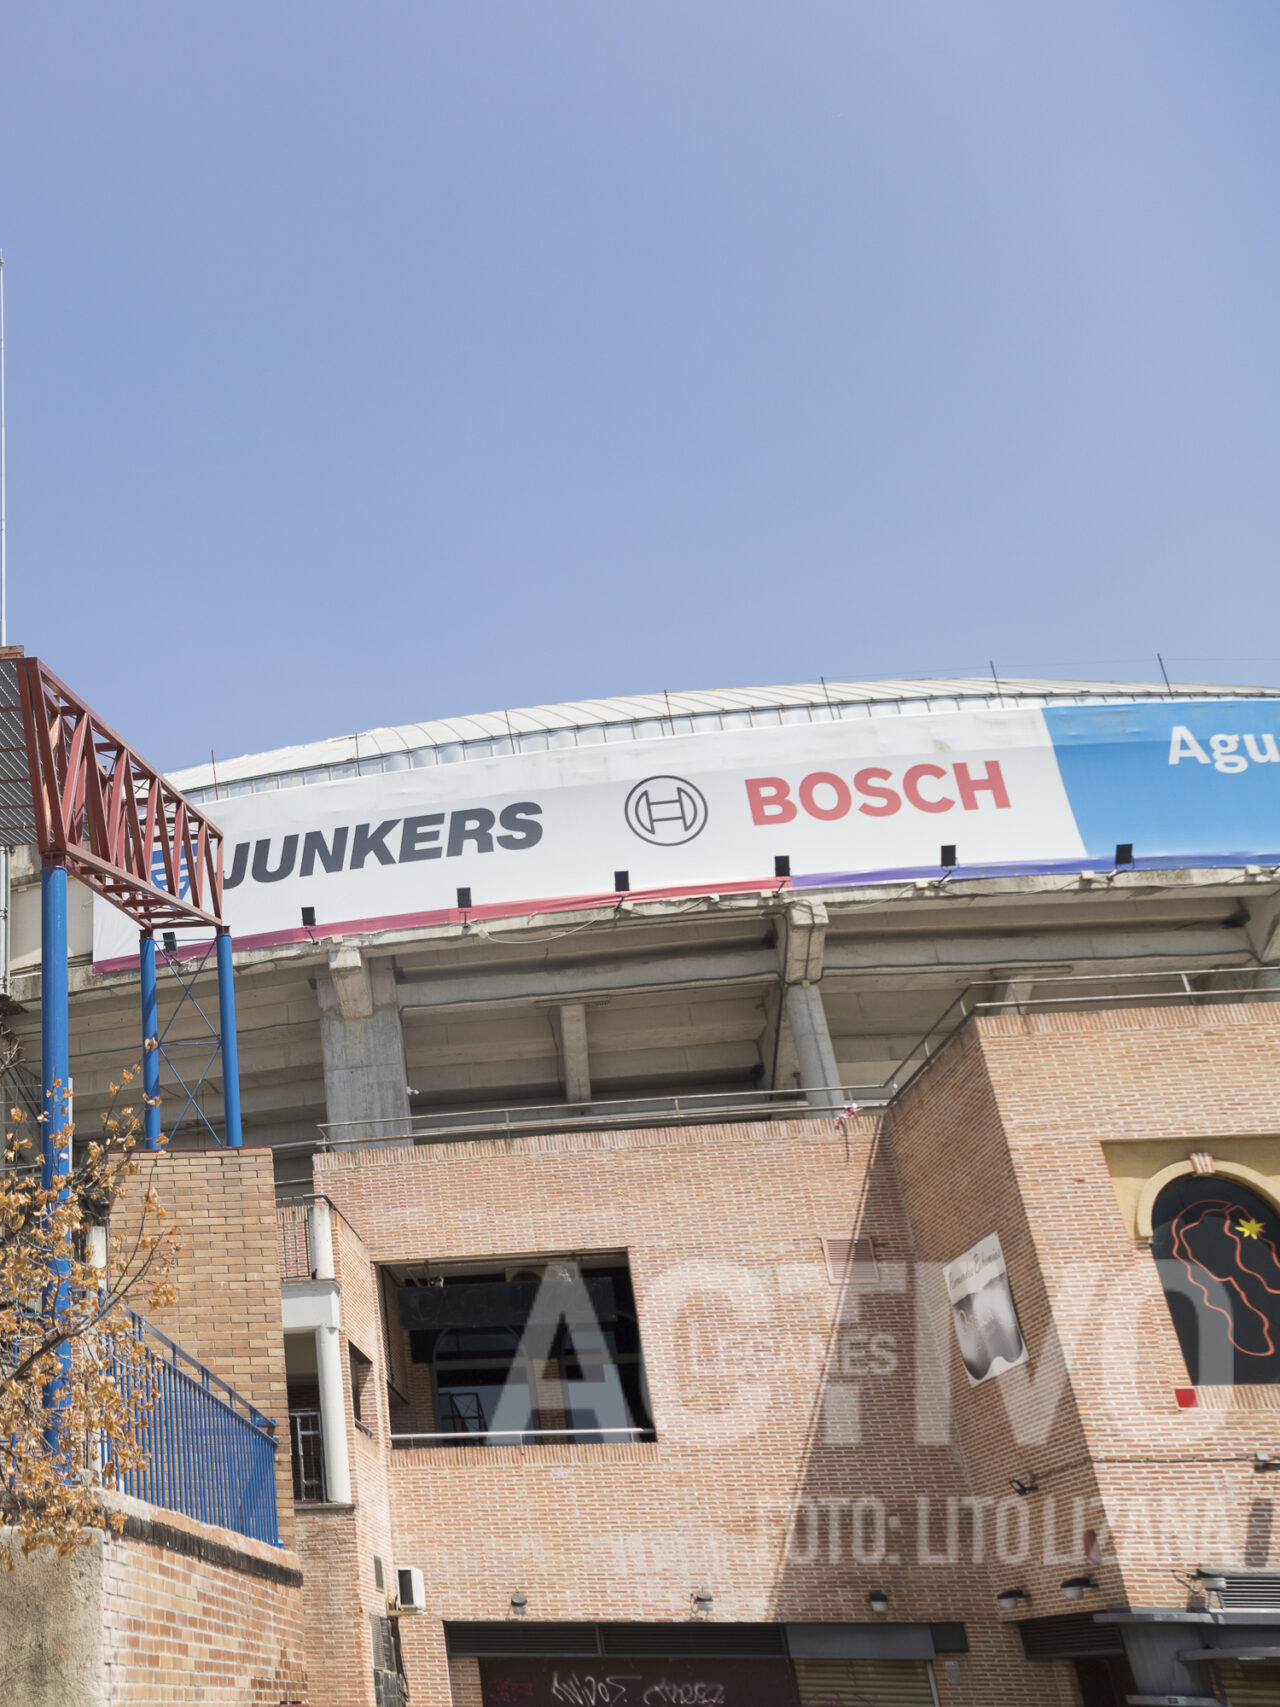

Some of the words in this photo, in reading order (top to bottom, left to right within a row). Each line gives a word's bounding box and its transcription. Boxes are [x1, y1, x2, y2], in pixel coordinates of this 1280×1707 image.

[1168, 725, 1280, 774] Agu
[744, 759, 1012, 827] BOSCH
[215, 801, 544, 890] JUNKERS
